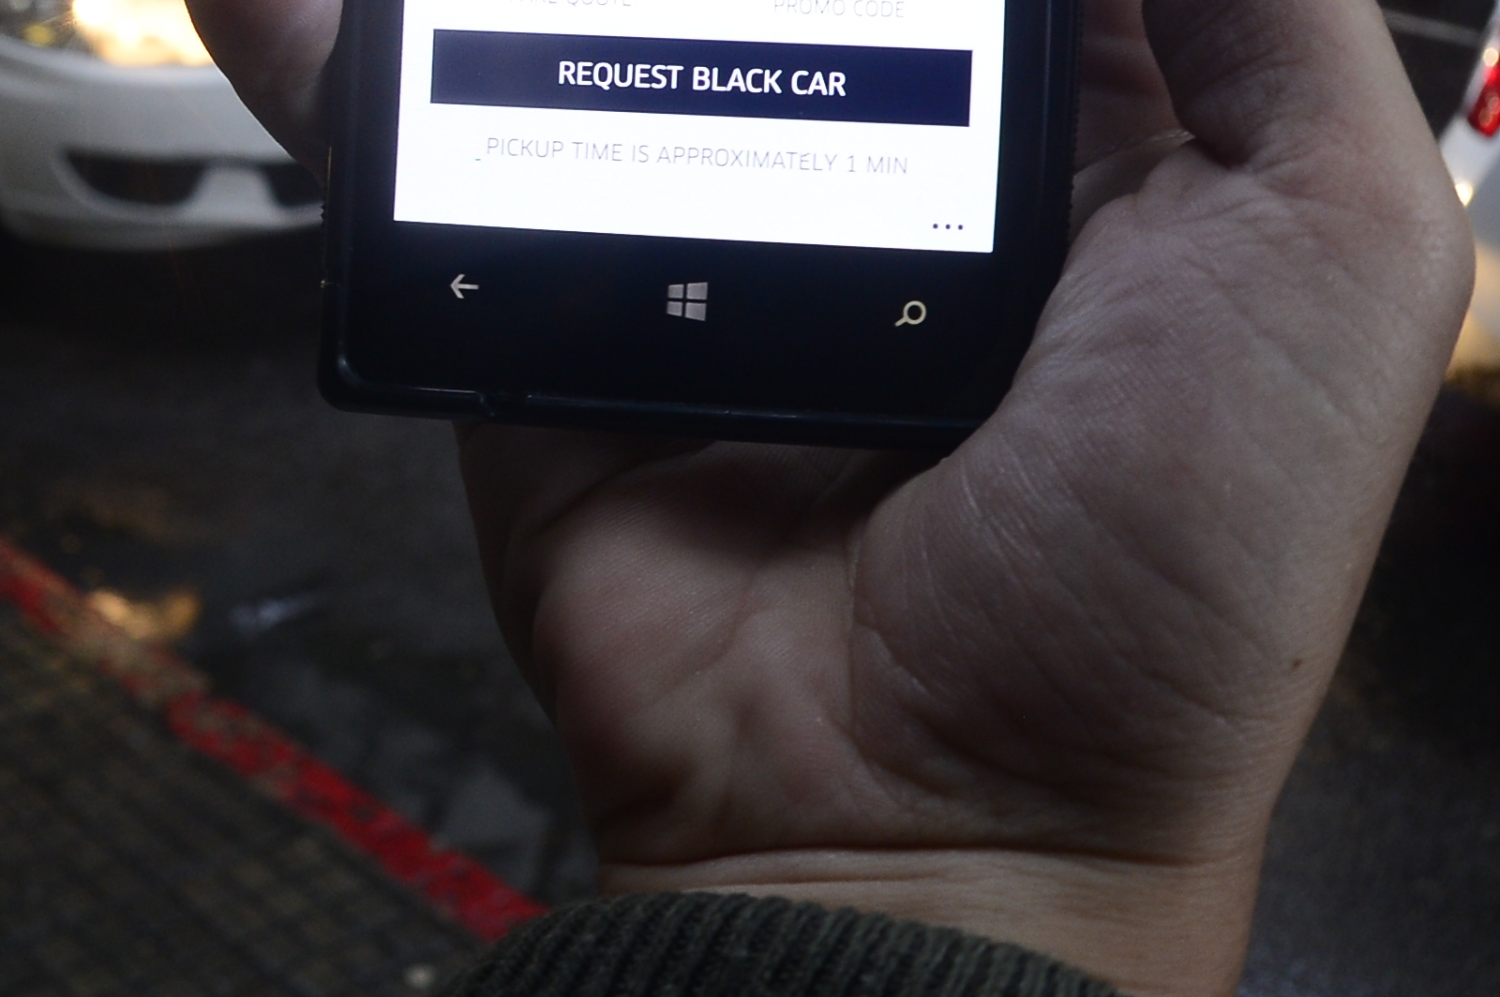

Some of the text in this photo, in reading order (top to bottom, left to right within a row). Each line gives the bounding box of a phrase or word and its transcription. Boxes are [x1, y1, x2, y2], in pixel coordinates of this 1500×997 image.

[853, 0, 905, 18] CODE
[559, 61, 845, 96] REQUEST BLACK CAR
[486, 137, 908, 174] PICKUP TIME IS APPROXIMATELY 1 MIN
